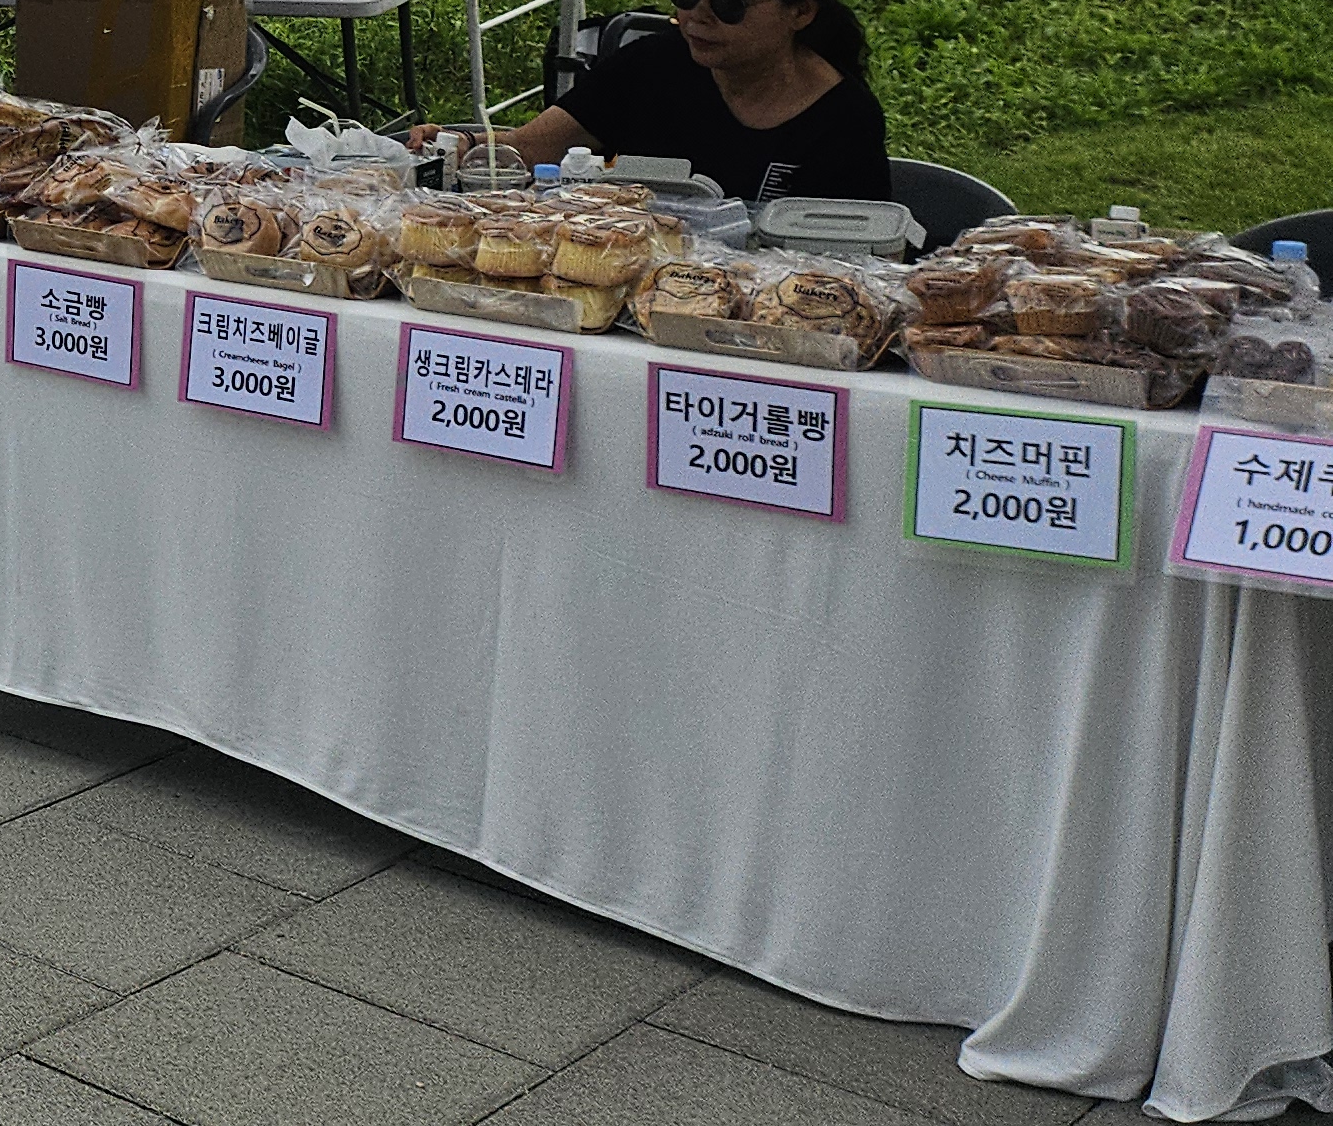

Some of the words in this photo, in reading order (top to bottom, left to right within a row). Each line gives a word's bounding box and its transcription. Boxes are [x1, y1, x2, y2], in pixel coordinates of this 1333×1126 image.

[40, 288, 108, 321] 소금빵
[35, 326, 108, 362] 3,000원
[197, 312, 320, 356] 크림치즈베이글
[212, 366, 296, 403] 3,000원
[414, 349, 554, 398] 생크림카스테라
[431, 399, 526, 439] 2,000원
[665, 391, 830, 441] 타이거롤빵
[689, 444, 798, 486] 2,000원
[945, 432, 1092, 478] 치즈머핀
[953, 488, 1078, 530] 2,000원
